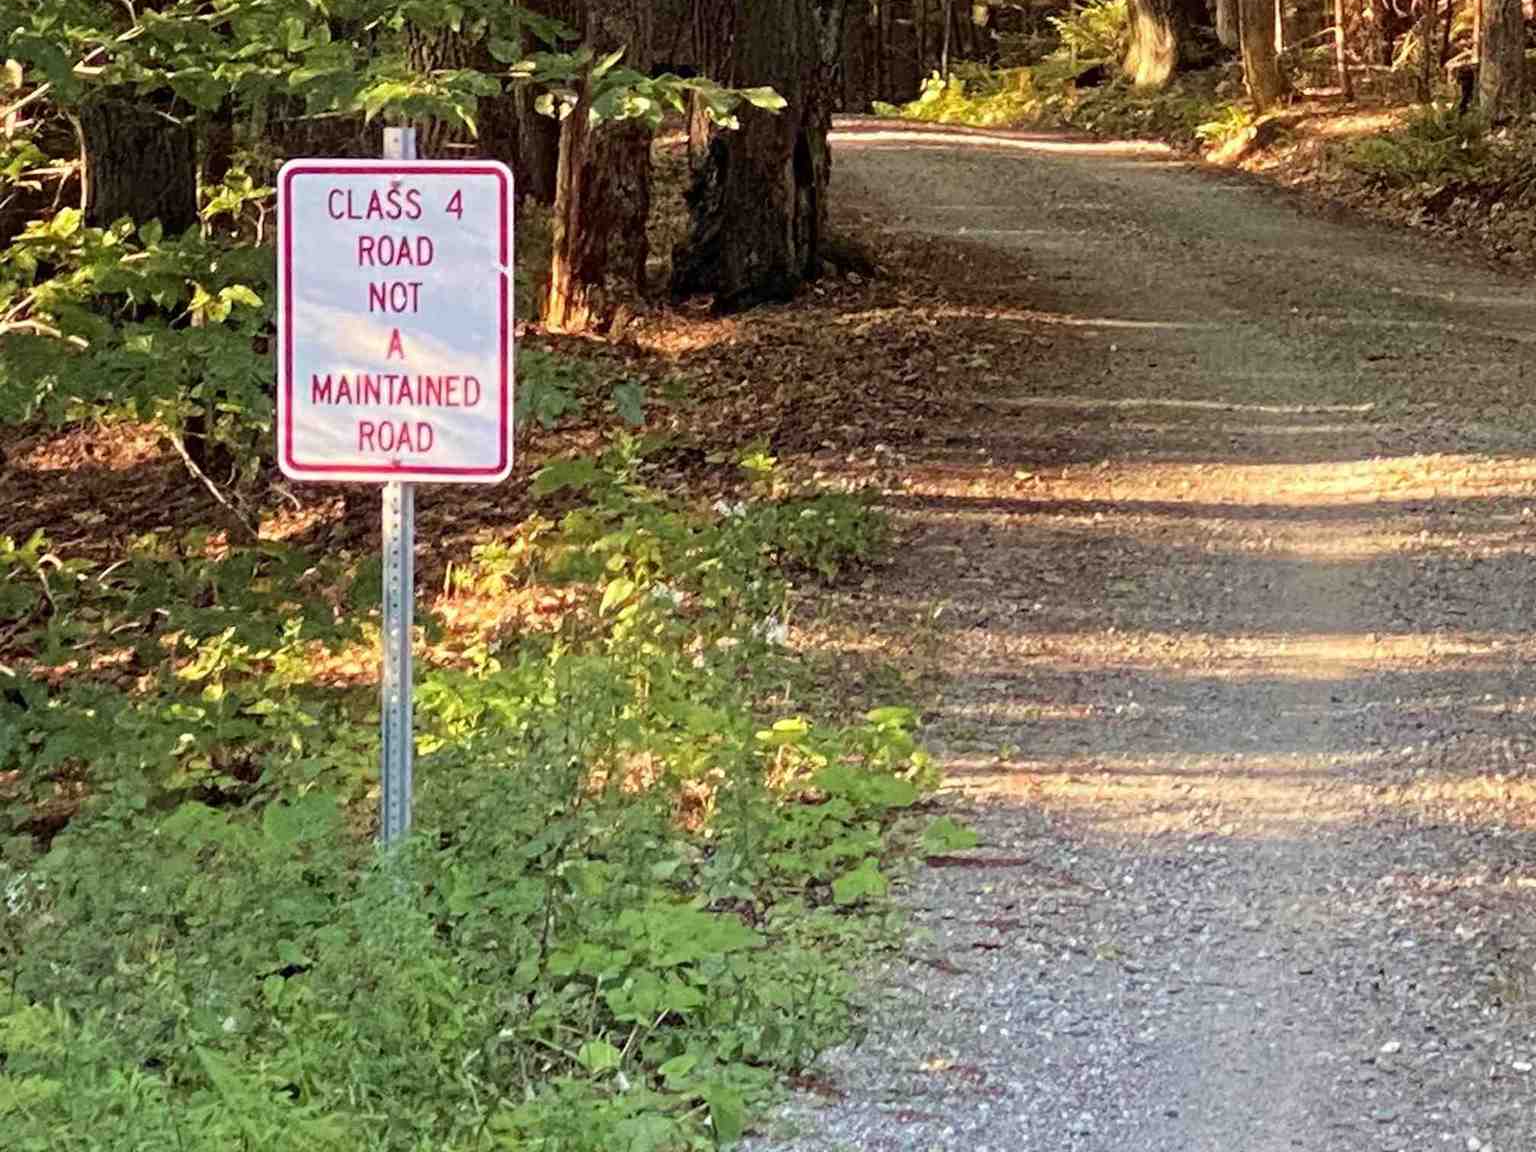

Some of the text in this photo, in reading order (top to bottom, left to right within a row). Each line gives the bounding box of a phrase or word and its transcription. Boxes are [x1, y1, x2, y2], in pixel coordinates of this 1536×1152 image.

[327, 188, 464, 221] CLASS 4
[358, 235, 434, 267] ROAD
[368, 282, 423, 313] NOT
[386, 328, 405, 359] A
[311, 374, 481, 407] MAINTAINED
[358, 421, 434, 453] ROAD
